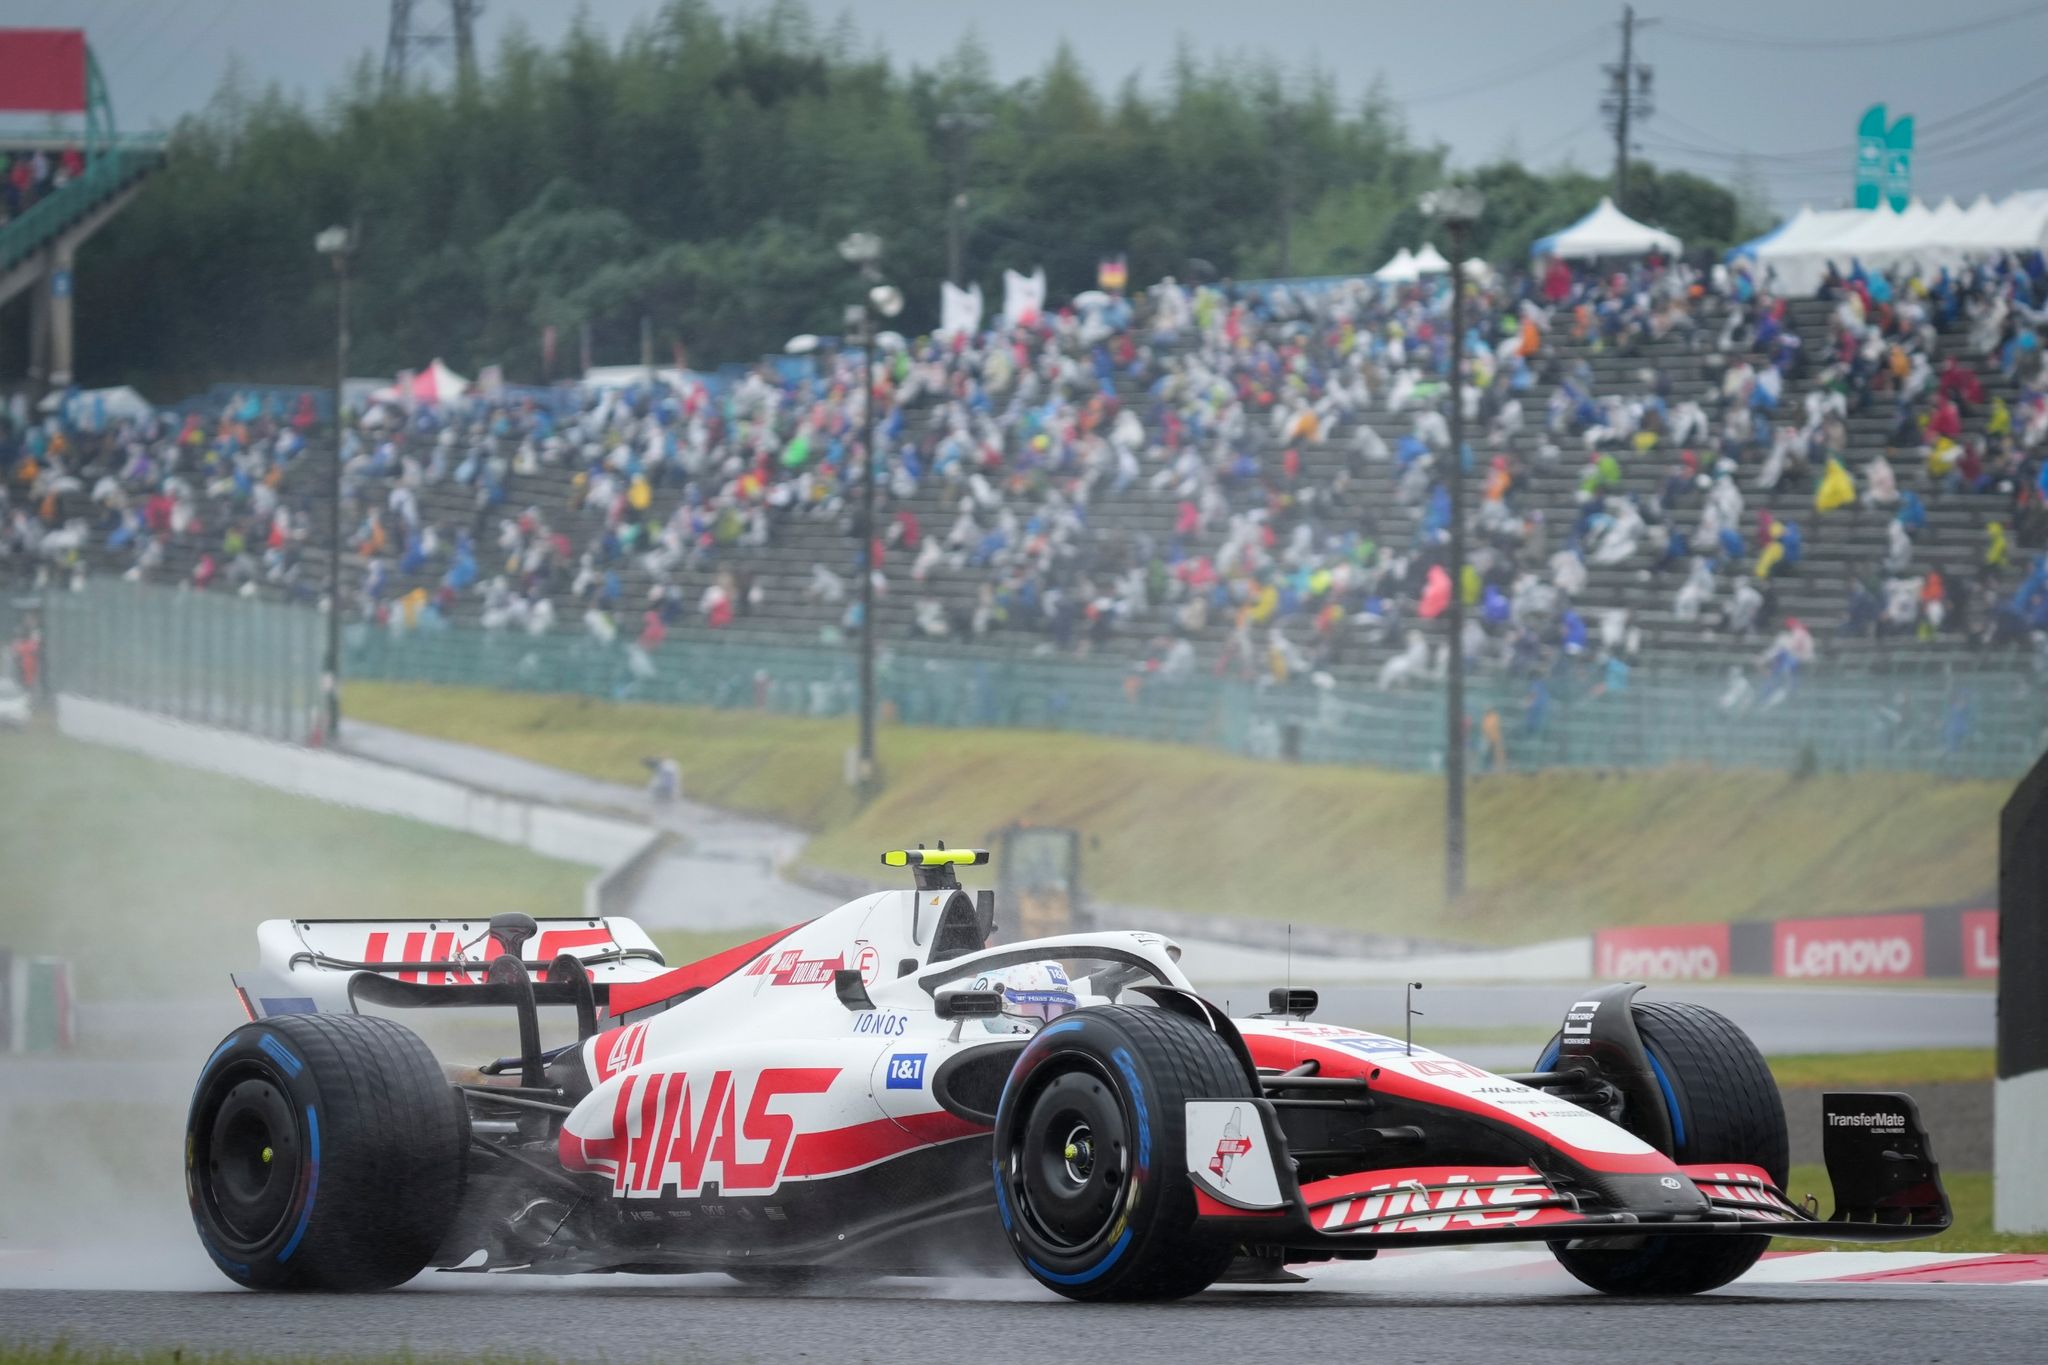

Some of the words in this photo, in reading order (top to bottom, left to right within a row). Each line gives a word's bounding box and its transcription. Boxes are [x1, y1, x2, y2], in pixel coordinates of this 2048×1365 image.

[1602, 945, 1717, 977] Lenovo
[1785, 933, 1911, 976] Lenovo
[853, 1013, 908, 1036] IONOS
[1567, 1013, 1595, 1021] TRICORP
[607, 1022, 649, 1073] 47
[891, 1060, 922, 1079] 1&1
[1411, 1061, 1488, 1078] 47
[585, 1067, 844, 1191] HAAS
[1827, 1112, 1905, 1127] TransferMate
[1322, 1175, 1555, 1234] HAAS
